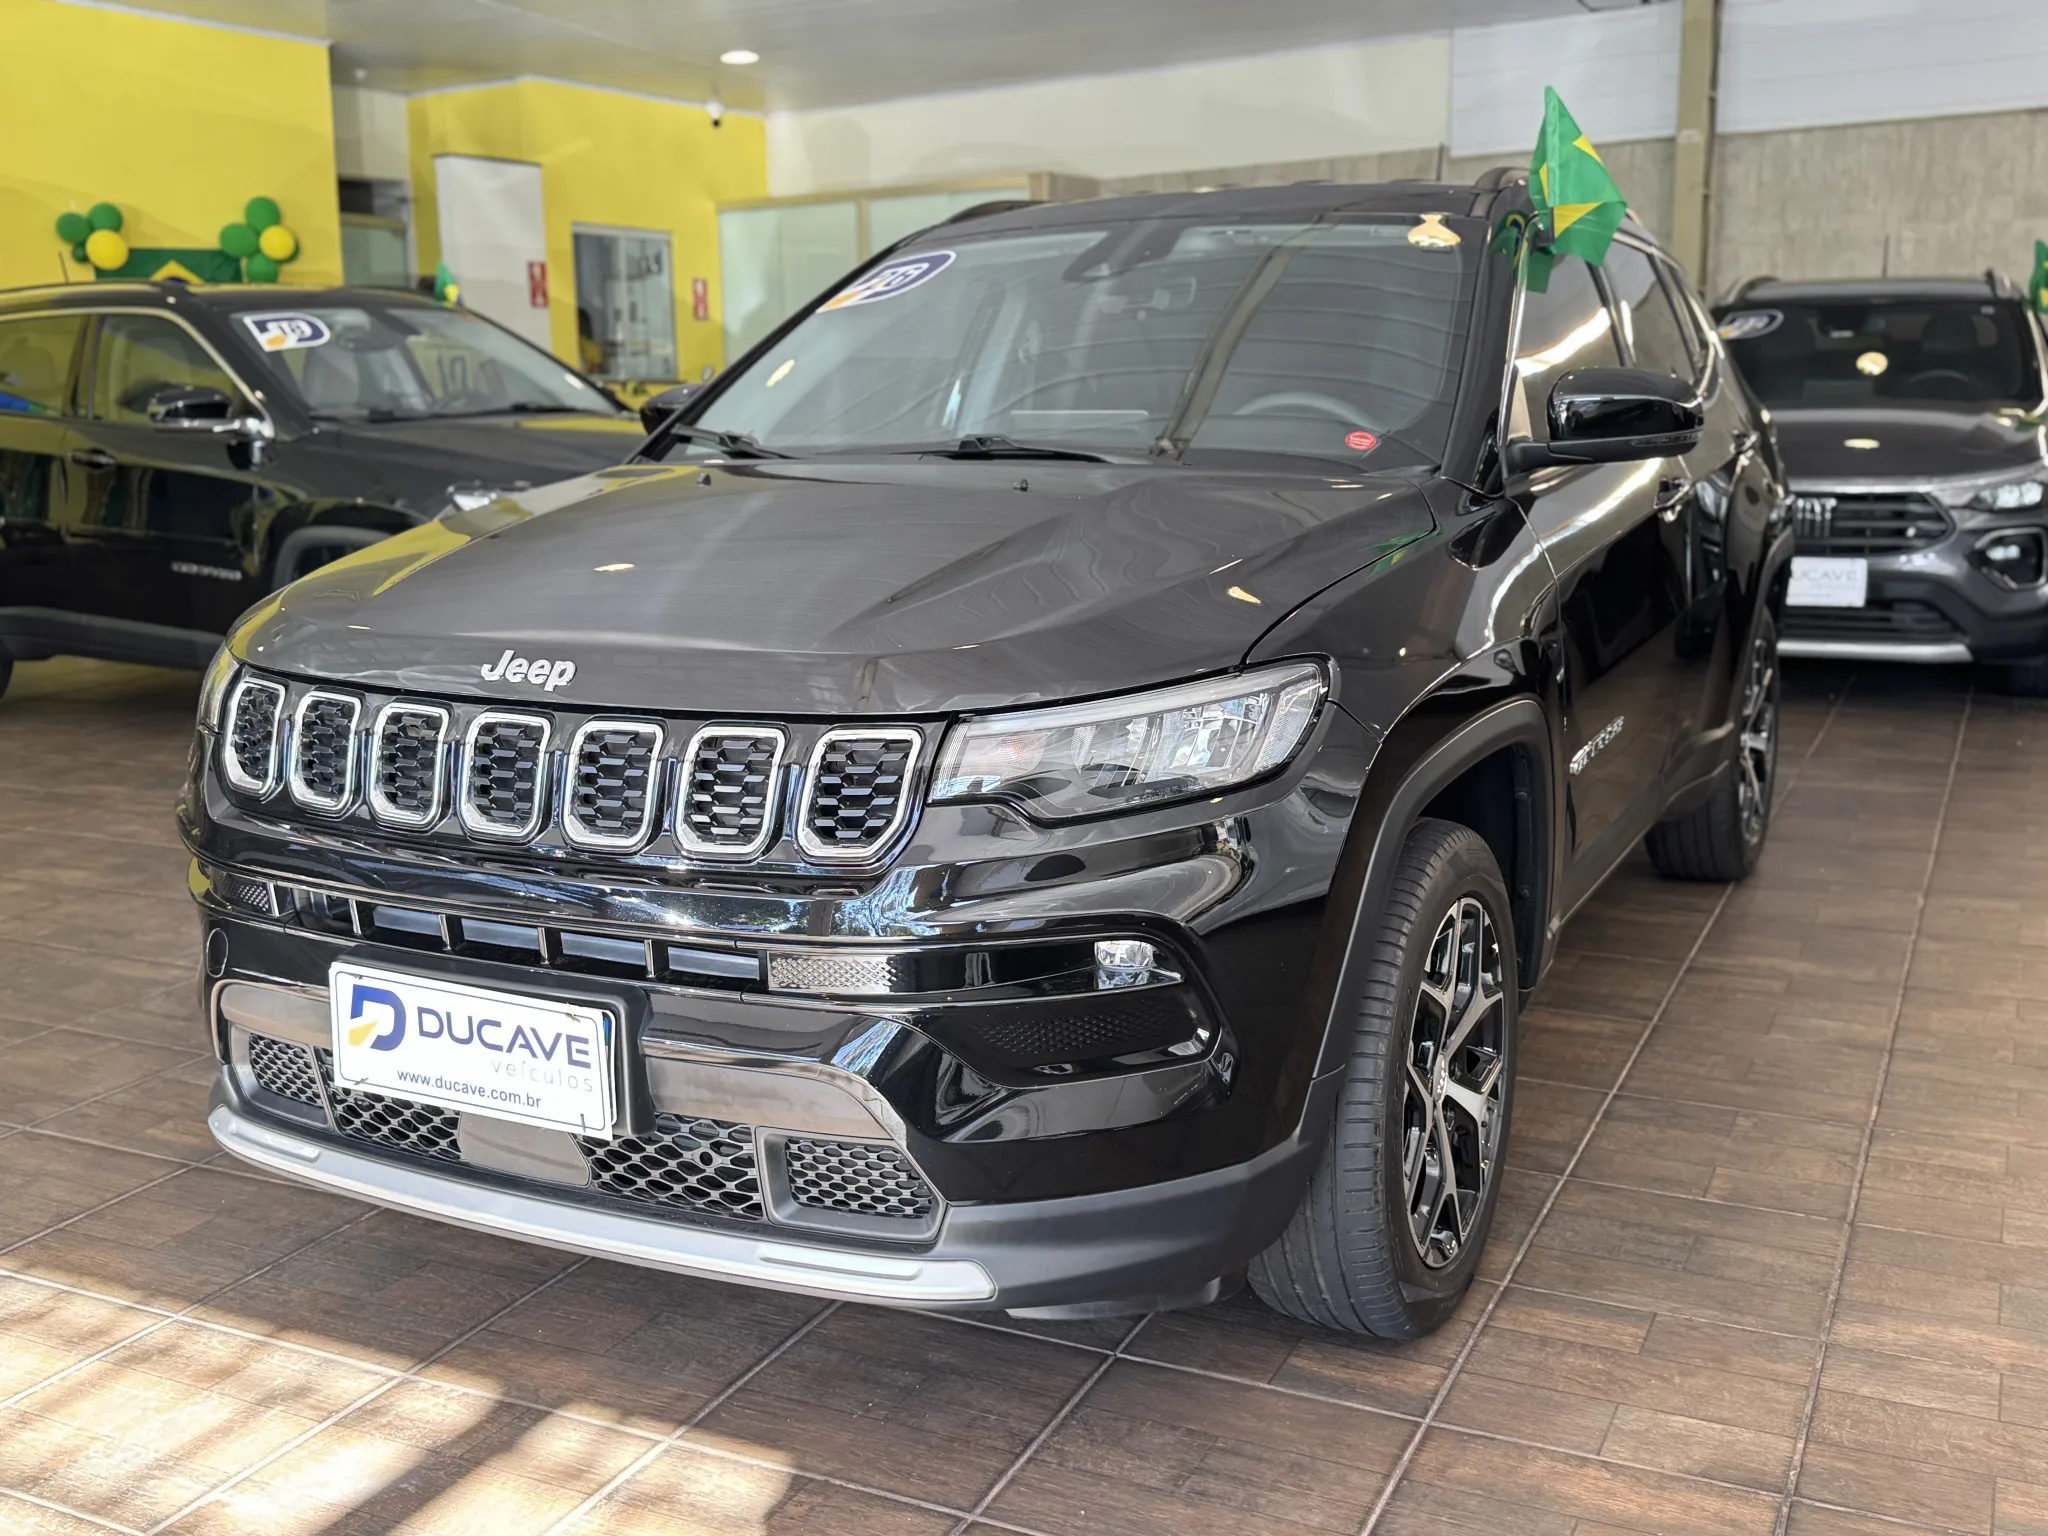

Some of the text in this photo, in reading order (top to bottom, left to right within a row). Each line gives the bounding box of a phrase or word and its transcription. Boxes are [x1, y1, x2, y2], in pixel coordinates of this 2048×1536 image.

[481, 649, 577, 692] Jeep
[416, 1006, 592, 1069] DUCAVE
[396, 1070, 542, 1109] www.ducave.com.br
[491, 1059, 594, 1093] veículos
